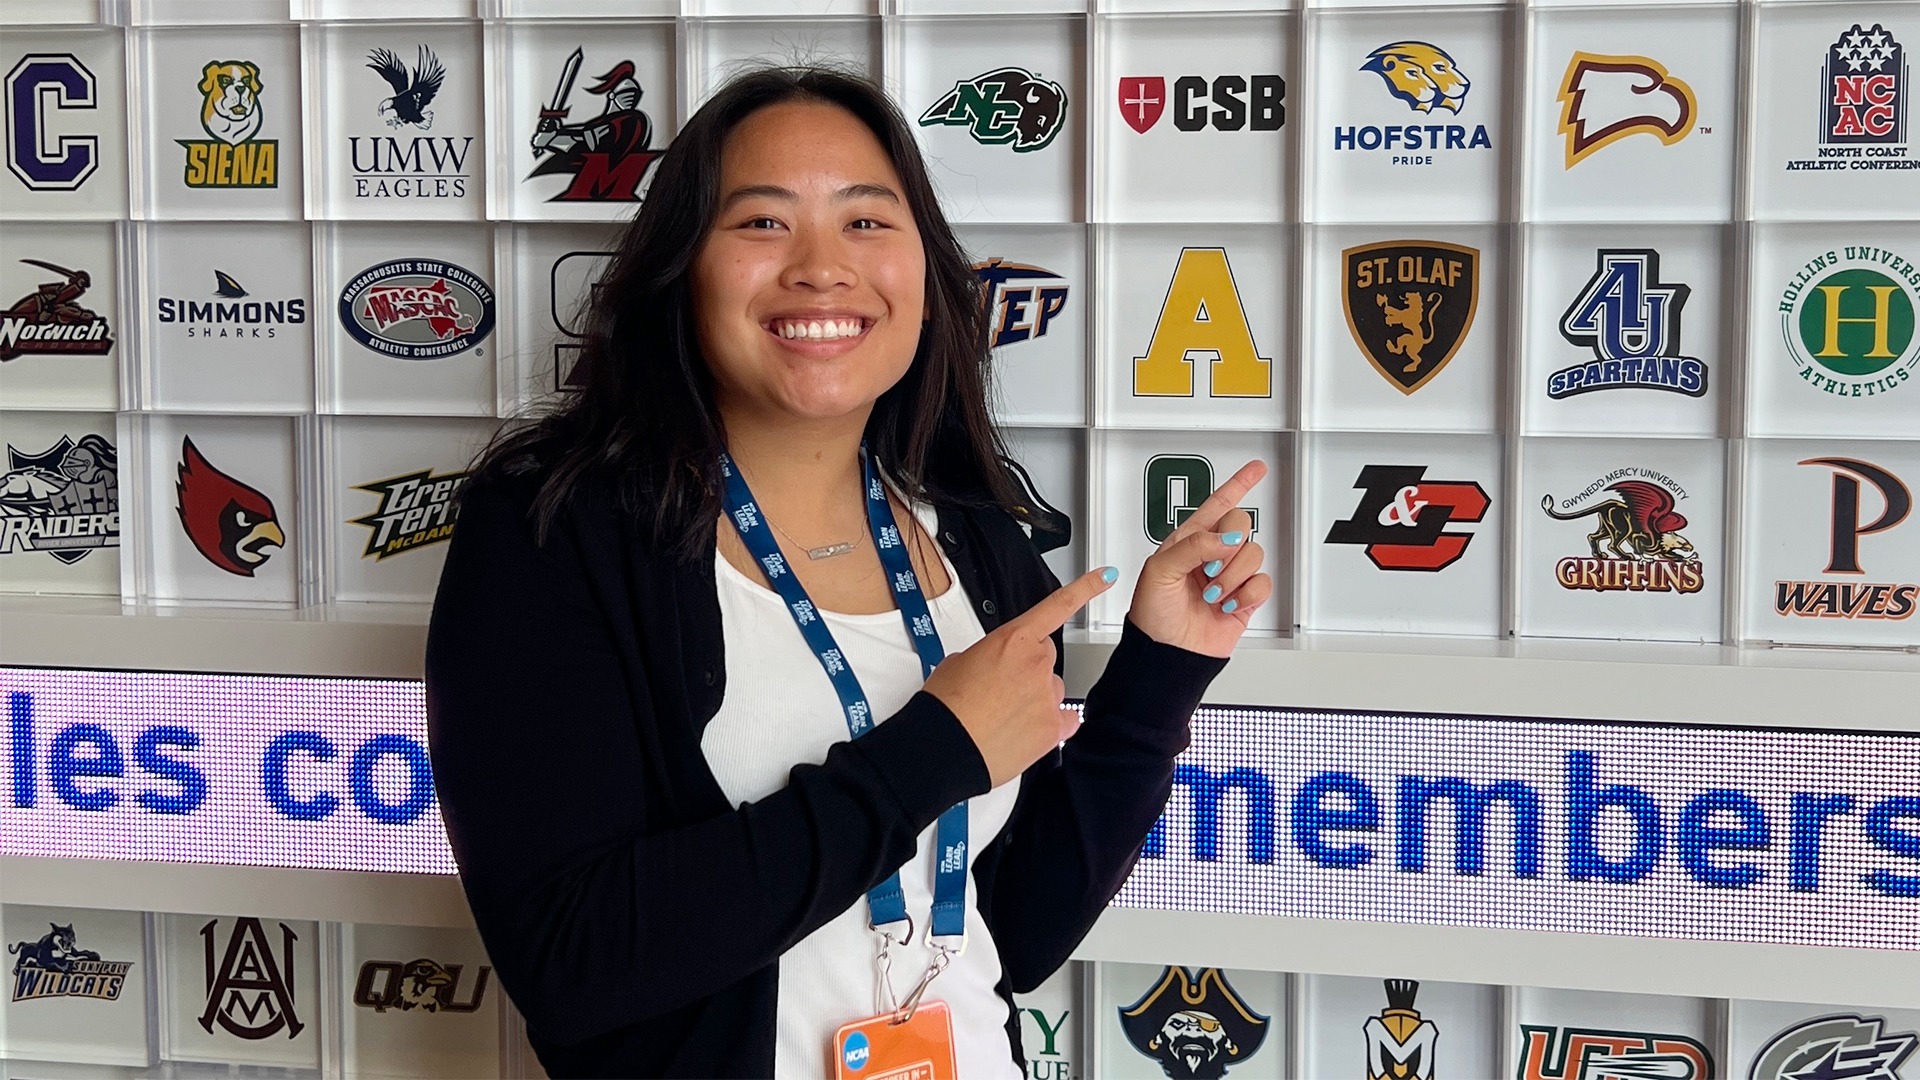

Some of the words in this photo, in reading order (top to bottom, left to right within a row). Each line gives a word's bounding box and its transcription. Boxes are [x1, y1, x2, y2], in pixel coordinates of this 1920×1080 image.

[946, 82, 1023, 143] NC
[1173, 74, 1286, 132] CSB
[4, 53, 99, 191] C
[1334, 124, 1492, 151] HOFSTRA
[187, 143, 275, 185] SIENA
[348, 137, 474, 173] UMW
[1392, 156, 1433, 165] PRIDE
[1786, 161, 1847, 171] ATHLETIC
[1818, 148, 1862, 158] NORTH
[1866, 148, 1908, 157] COAST
[355, 178, 466, 198] EAGLES
[558, 152, 662, 203] M
[343, 262, 412, 303] MASSACHUSETTS
[416, 262, 443, 274] STATE
[447, 267, 493, 304] COLLEGIATE
[1356, 257, 1393, 288] ST.
[1397, 256, 1463, 287] OLAF
[1778, 250, 1838, 314] HOLLINS
[1844, 246, 1920, 300] UNIVERS
[158, 298, 305, 323] SIMMONS
[367, 290, 461, 330] MASCAC
[1133, 246, 1272, 398] A
[1813, 285, 1900, 359] H
[0, 317, 104, 349] Norwich
[188, 327, 276, 338] SHARKS
[368, 337, 410, 356] ATHLETIC
[413, 338, 470, 357] CONFERENCE
[1550, 357, 1703, 397] SPARTANS
[1799, 366, 1909, 398] ATHLETICS
[1562, 478, 1606, 509] GWYNEDD
[1605, 467, 1638, 483] MERCY
[1640, 467, 1689, 501] UNIVERSITY
[735, 509, 750, 527] LEAD
[741, 504, 758, 527] LEARN
[1797, 457, 1913, 575] P
[0, 512, 119, 551] RAIDERS
[387, 523, 456, 553] McDAN
[880, 527, 892, 549] LEARN
[888, 527, 899, 546] LEAD
[769, 553, 787, 574] LEARN
[1556, 556, 1705, 594] GRIFFINS
[798, 600, 816, 621] LEARN
[1775, 581, 1920, 620] WAVES
[827, 649, 845, 671] LEARN
[850, 705, 860, 726] LEAD
[855, 702, 867, 728] LEARN
[945, 845, 954, 873] LEARN
[953, 848, 961, 870] LEAD
[16, 968, 124, 998] WILDCATS
[845, 1046, 870, 1064] NCAA
